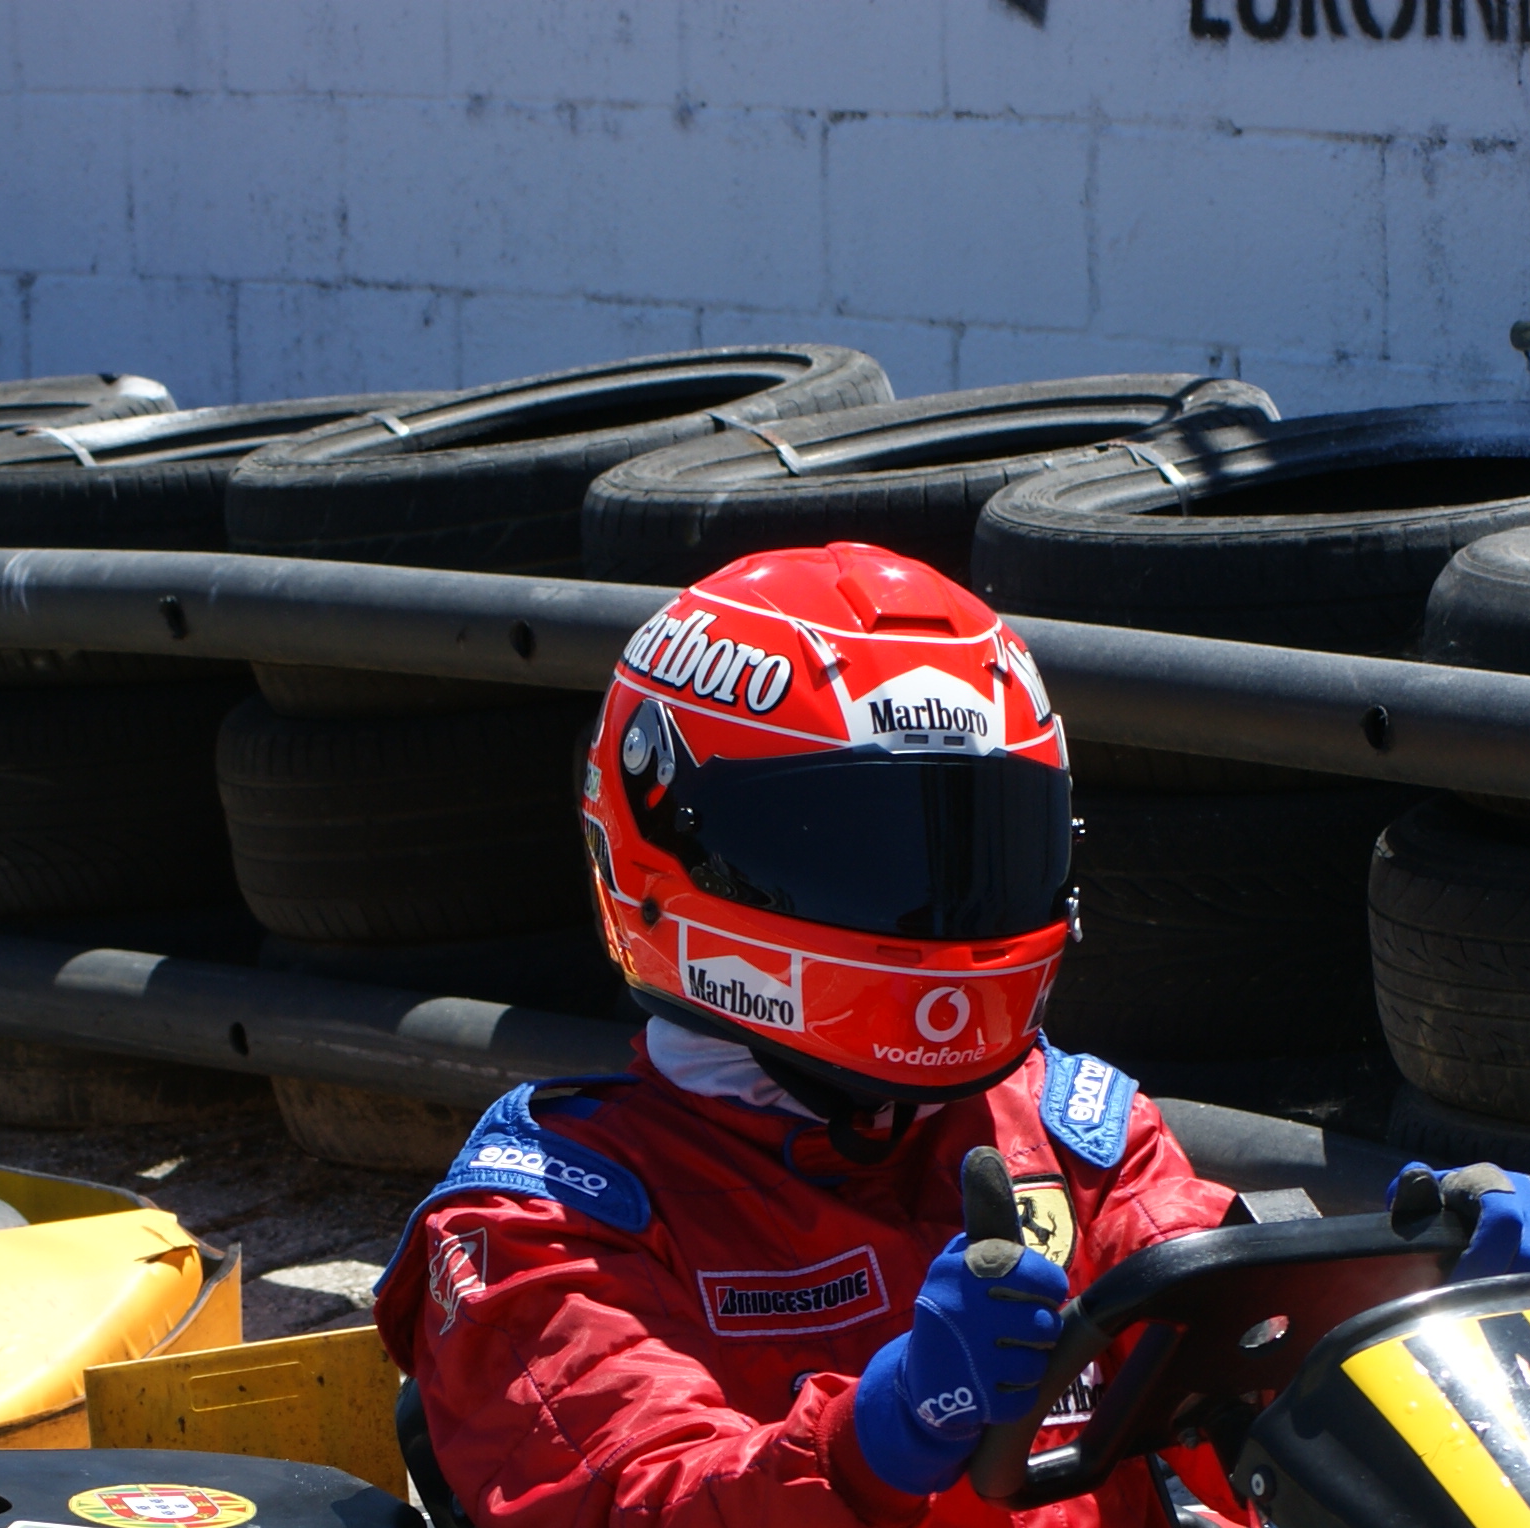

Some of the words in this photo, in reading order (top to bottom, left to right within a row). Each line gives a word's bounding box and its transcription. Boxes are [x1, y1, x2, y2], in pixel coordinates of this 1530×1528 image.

[868, 697, 989, 738] Marlboro
[687, 964, 796, 1027] Marlboro
[872, 1043, 988, 1068] vodafone
[1068, 1059, 1113, 1123] sparco
[471, 1146, 608, 1197] sparco
[716, 1267, 869, 1316] BRIDGESTONE
